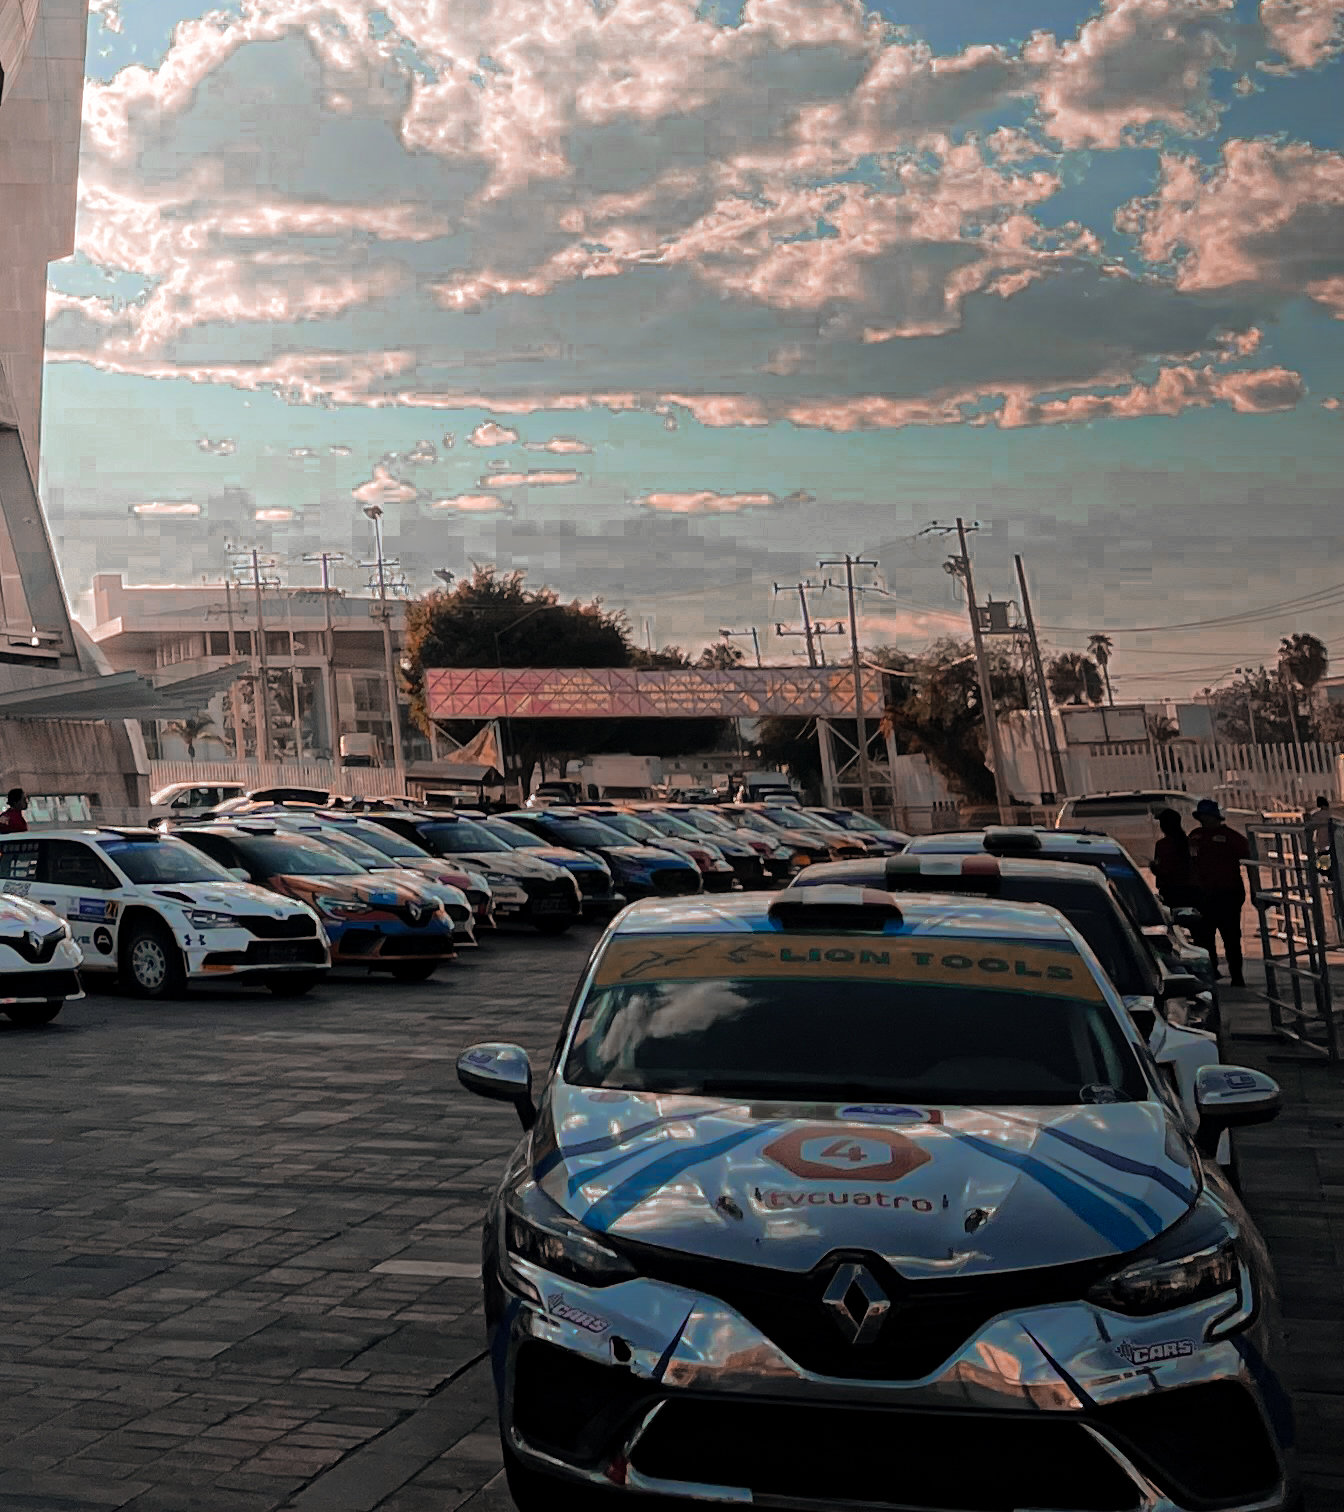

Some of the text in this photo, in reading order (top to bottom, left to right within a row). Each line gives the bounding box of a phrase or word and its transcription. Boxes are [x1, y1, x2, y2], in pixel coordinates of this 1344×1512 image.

[780, 947, 1074, 981] LION TOOLS
[820, 1140, 868, 1162] 4
[770, 1190, 933, 1213] tvcuatro
[552, 1304, 610, 1333] CARS
[1132, 1339, 1193, 1365] CARS
